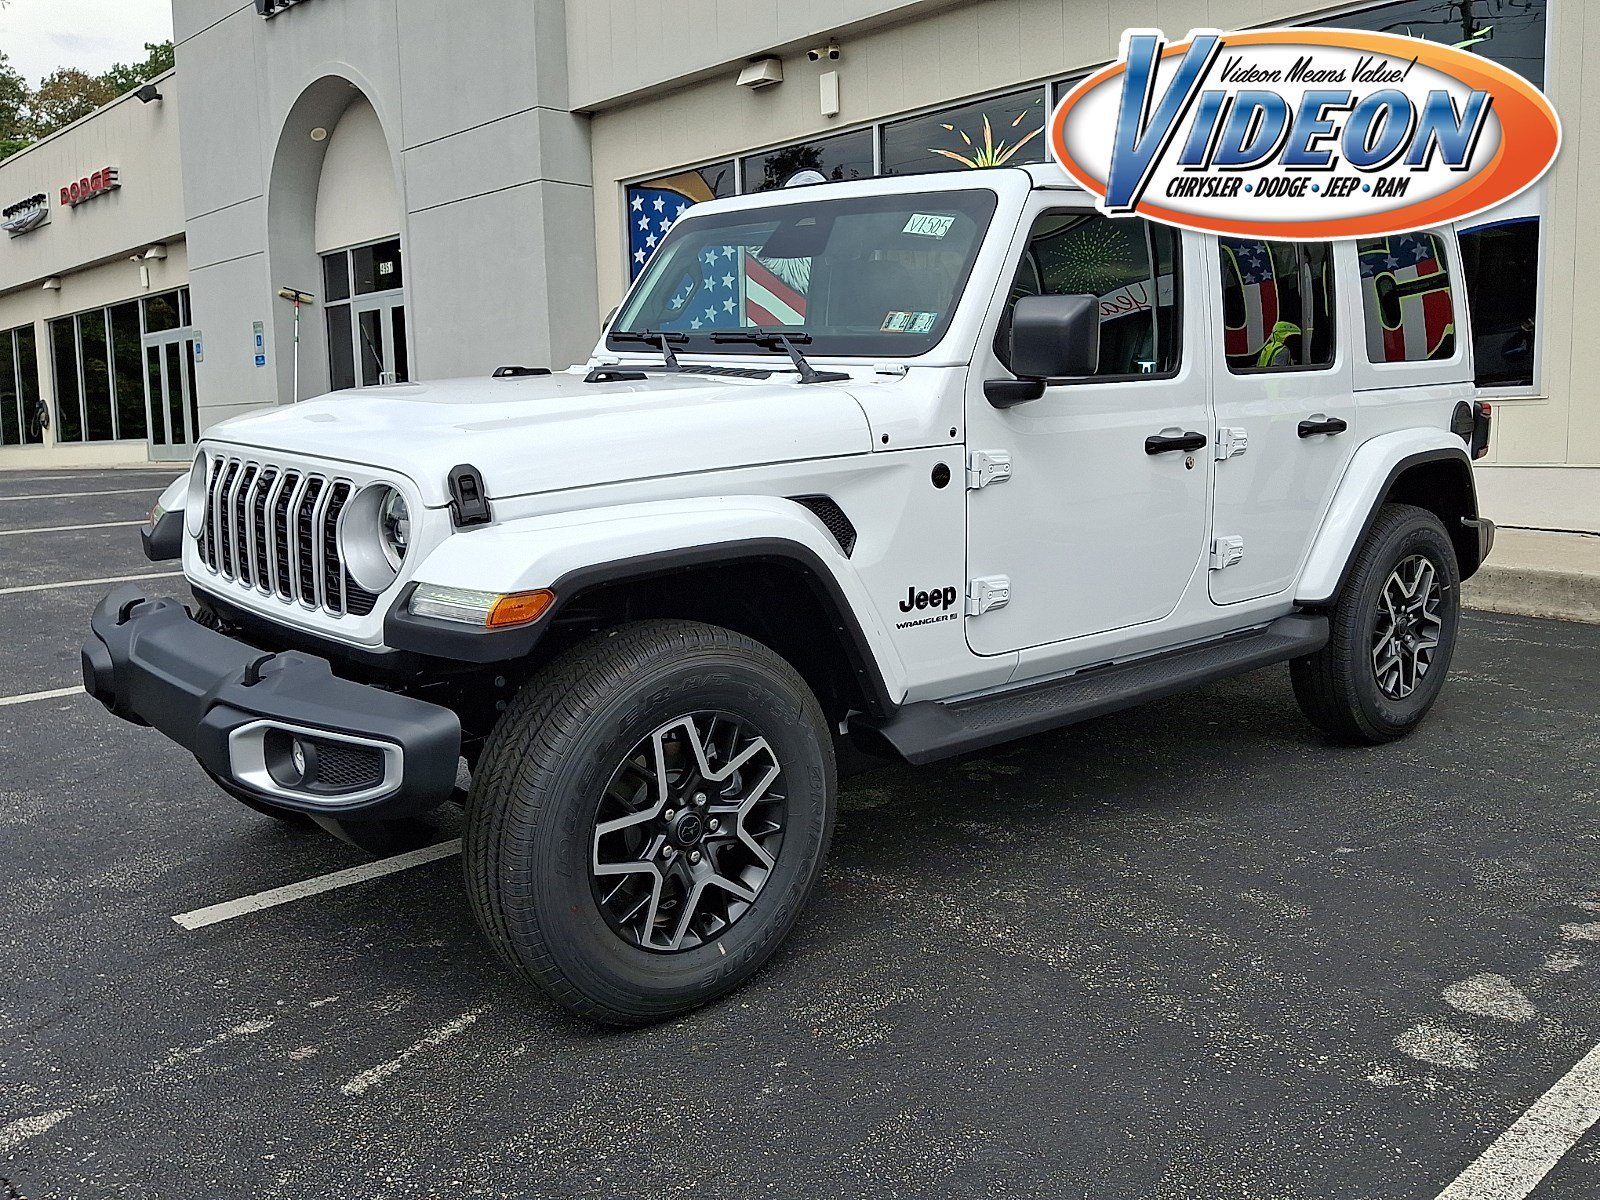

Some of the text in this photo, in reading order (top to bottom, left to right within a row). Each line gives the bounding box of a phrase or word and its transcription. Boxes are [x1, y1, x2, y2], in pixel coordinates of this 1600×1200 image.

[60, 167, 118, 206] DODGE
[899, 586, 957, 613] Jeep
[896, 614, 949, 630] WRANGLER
